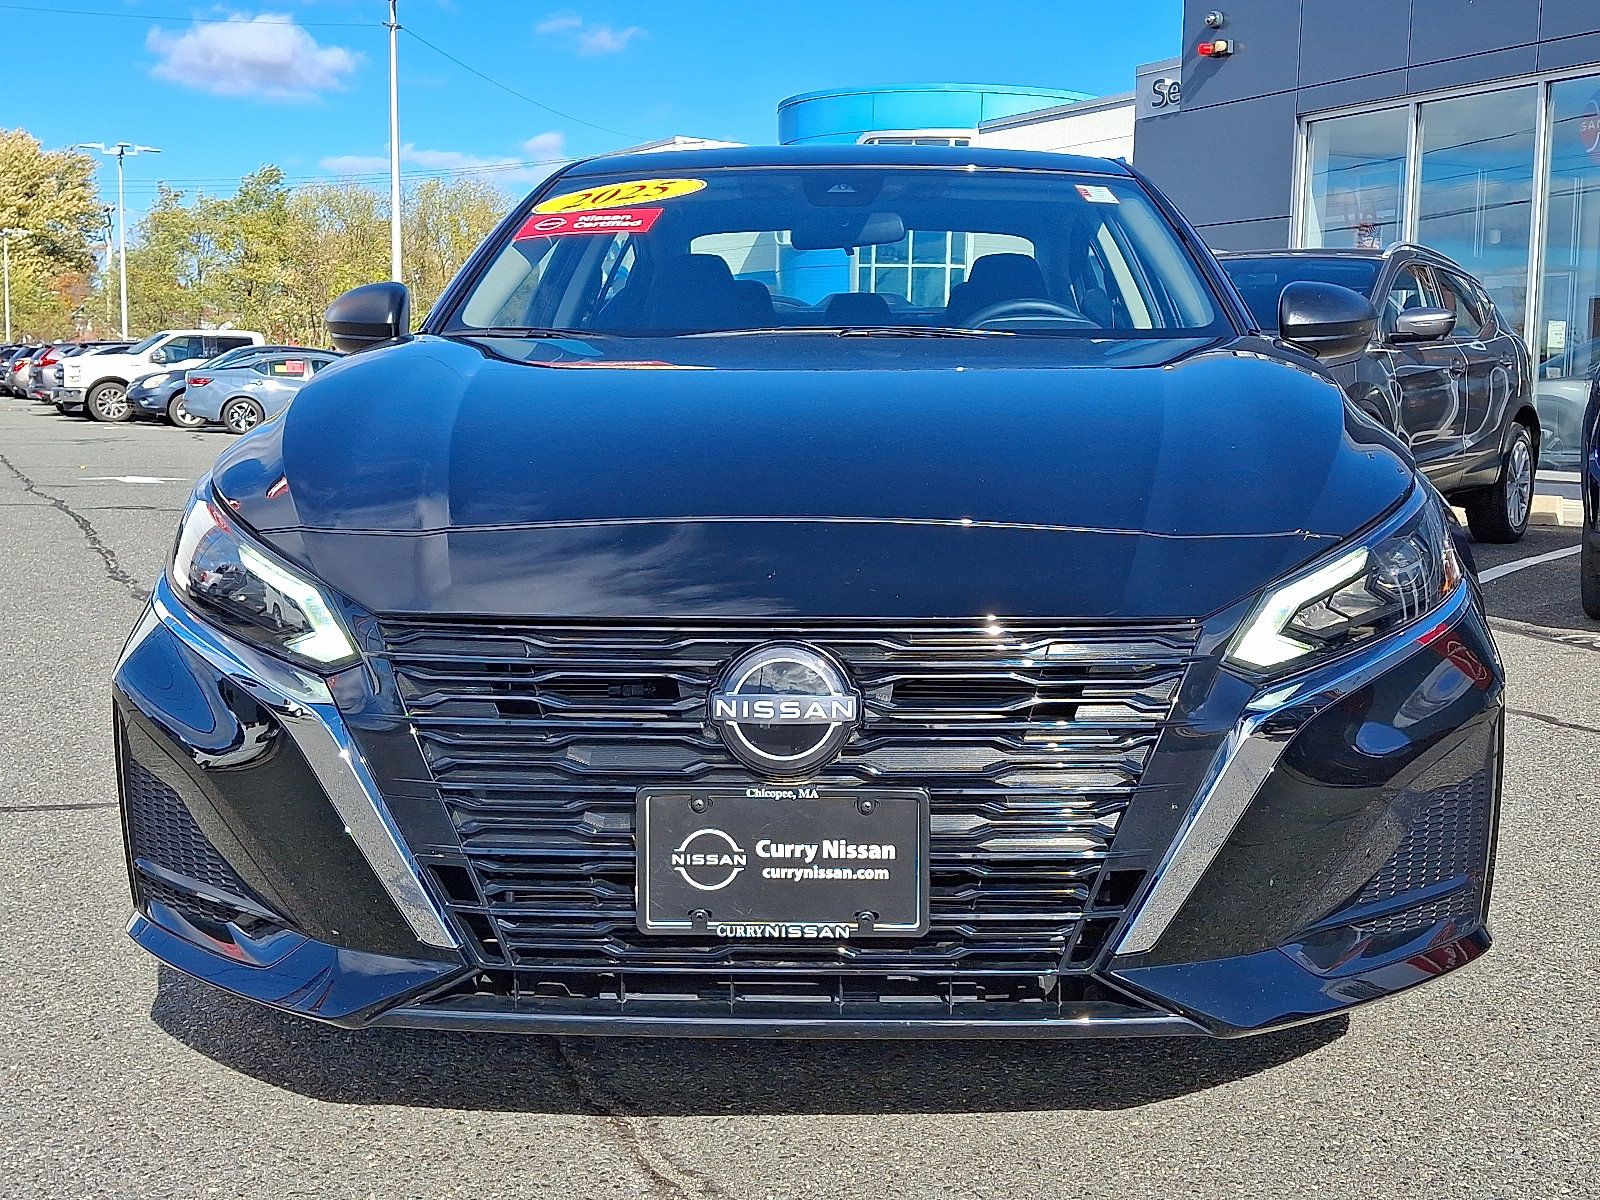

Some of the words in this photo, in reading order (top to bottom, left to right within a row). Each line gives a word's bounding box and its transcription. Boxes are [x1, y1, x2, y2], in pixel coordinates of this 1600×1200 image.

[561, 181, 677, 210] 2025
[573, 219, 643, 229] Certified
[578, 214, 631, 222] Nissan
[715, 700, 854, 720] NISSAN
[746, 788, 797, 800] Chicopee,
[798, 788, 819, 799] MA
[755, 839, 820, 863] Curry
[822, 839, 896, 860] Nissan
[672, 854, 747, 866] NISSAN
[762, 865, 889, 880] currynissan.com
